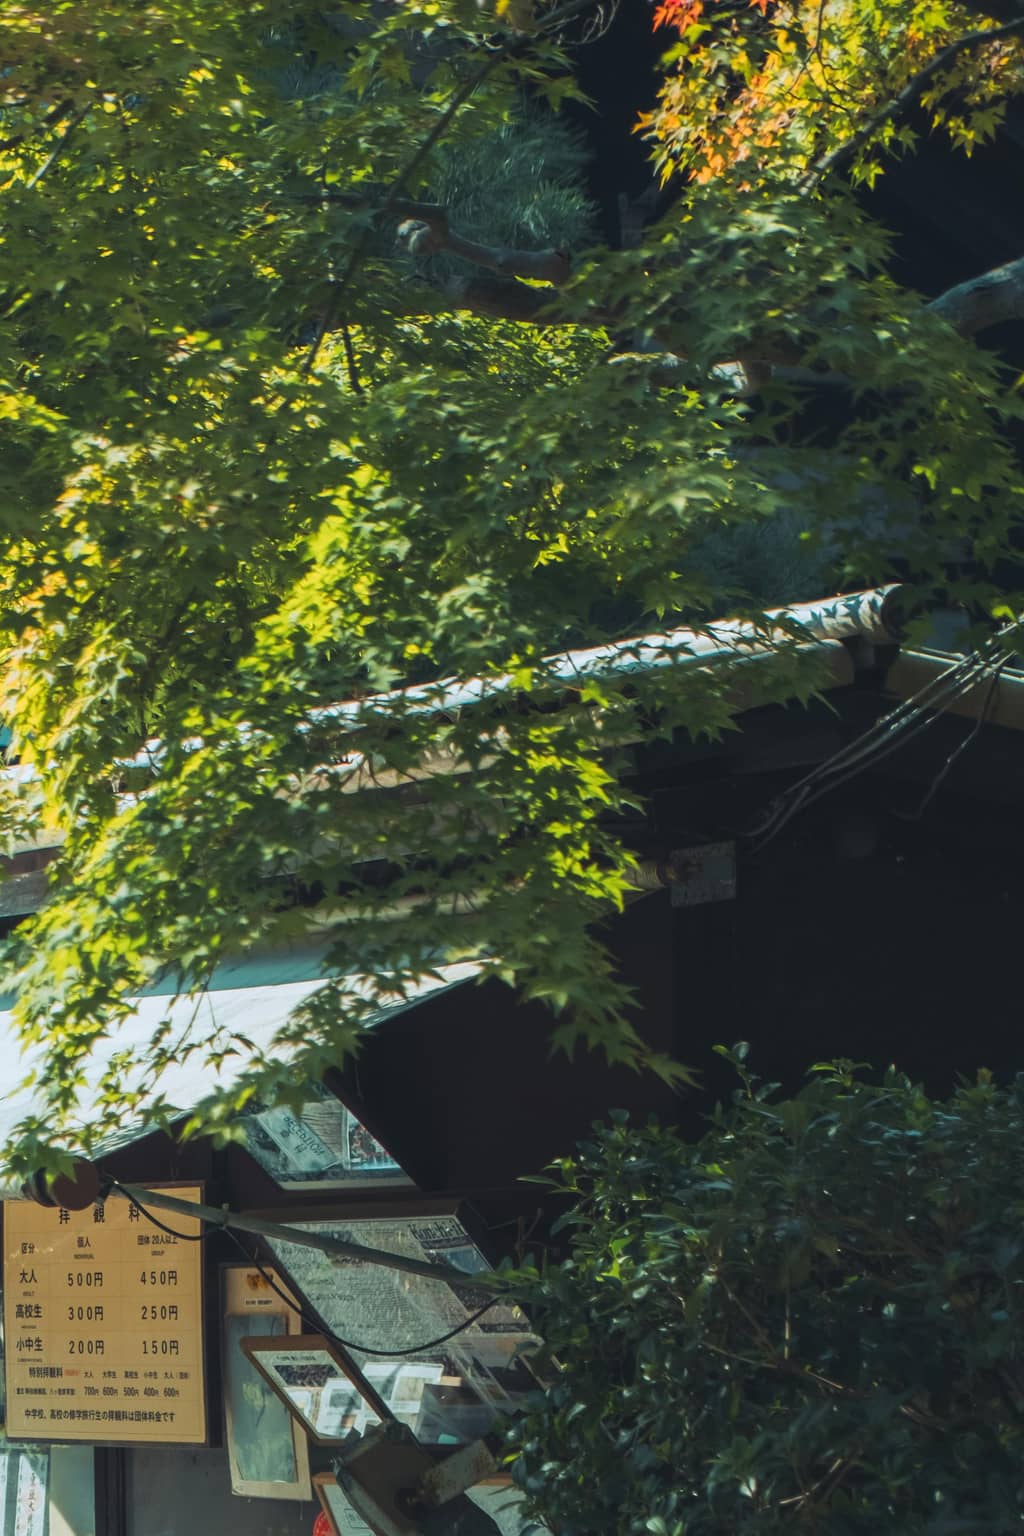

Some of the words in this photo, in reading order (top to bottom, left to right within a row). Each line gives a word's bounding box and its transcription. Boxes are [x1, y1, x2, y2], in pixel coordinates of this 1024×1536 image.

[21, 1242, 35, 1254] 区分
[19, 1268, 38, 1284] 大人
[67, 1272, 103, 1287] 500円
[140, 1270, 178, 1286] 450円
[15, 1304, 43, 1319] 高校生
[68, 1306, 104, 1321] 300円
[141, 1305, 178, 1320] 250円
[16, 1336, 44, 1352] 小中生
[68, 1340, 104, 1355] 200円
[142, 1340, 179, 1355] 150円
